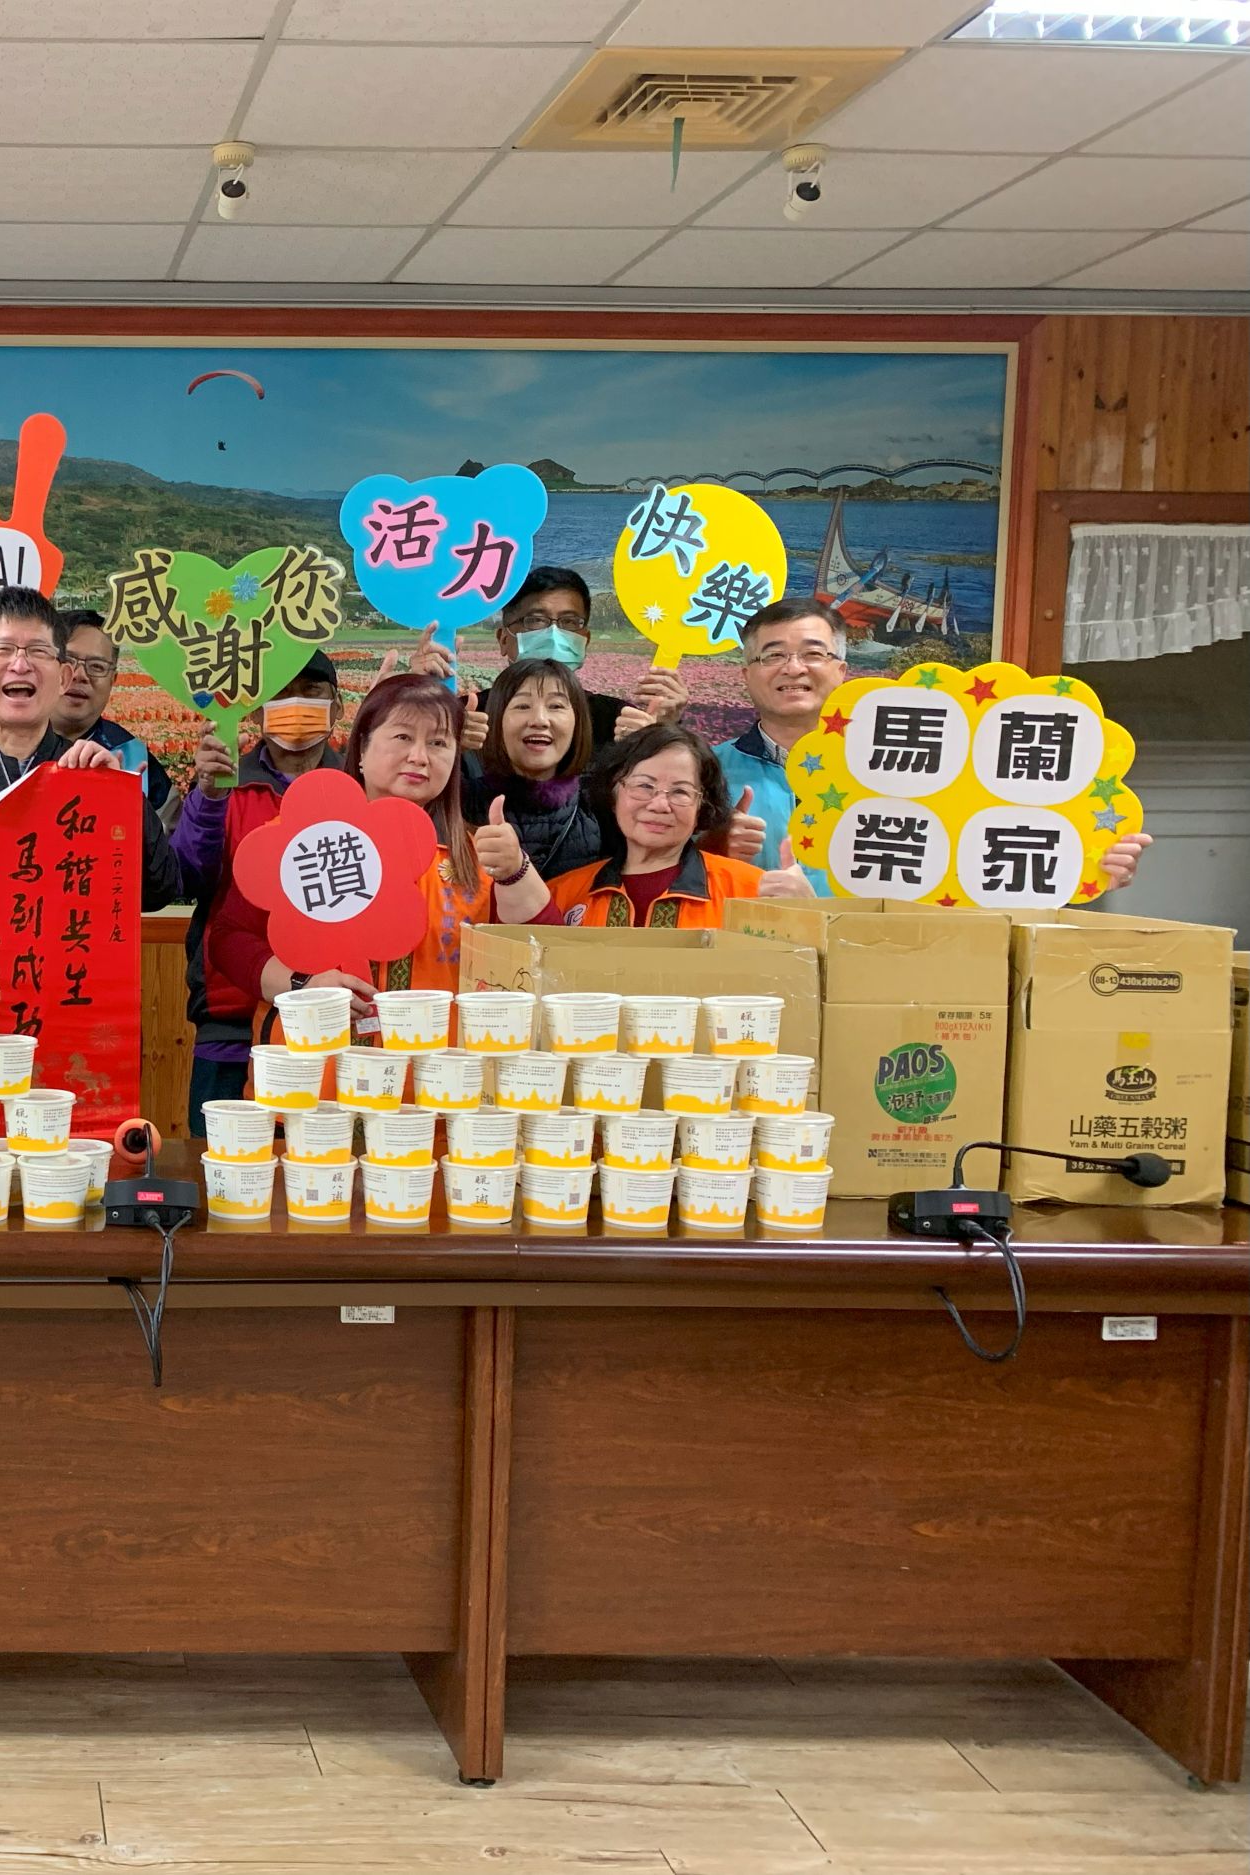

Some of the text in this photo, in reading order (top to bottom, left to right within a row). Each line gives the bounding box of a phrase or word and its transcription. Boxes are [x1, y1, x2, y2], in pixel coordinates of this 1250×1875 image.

[368, 500, 515, 599] 活力
[630, 487, 769, 641] 快樂
[107, 548, 339, 700] 感謝您
[868, 705, 1079, 781] 馬蘭
[293, 831, 374, 912] 讚
[850, 813, 1061, 894] 榮家
[8, 831, 46, 1037] 馬到成功
[54, 795, 99, 1006] 和諧共生
[877, 1044, 946, 1085] PAOS
[886, 1090, 925, 1113] 泡舒
[1069, 1140, 1186, 1150] Yam & Multi Grains Cereal
[1070, 1115, 1188, 1140] 山藥五穀粥
